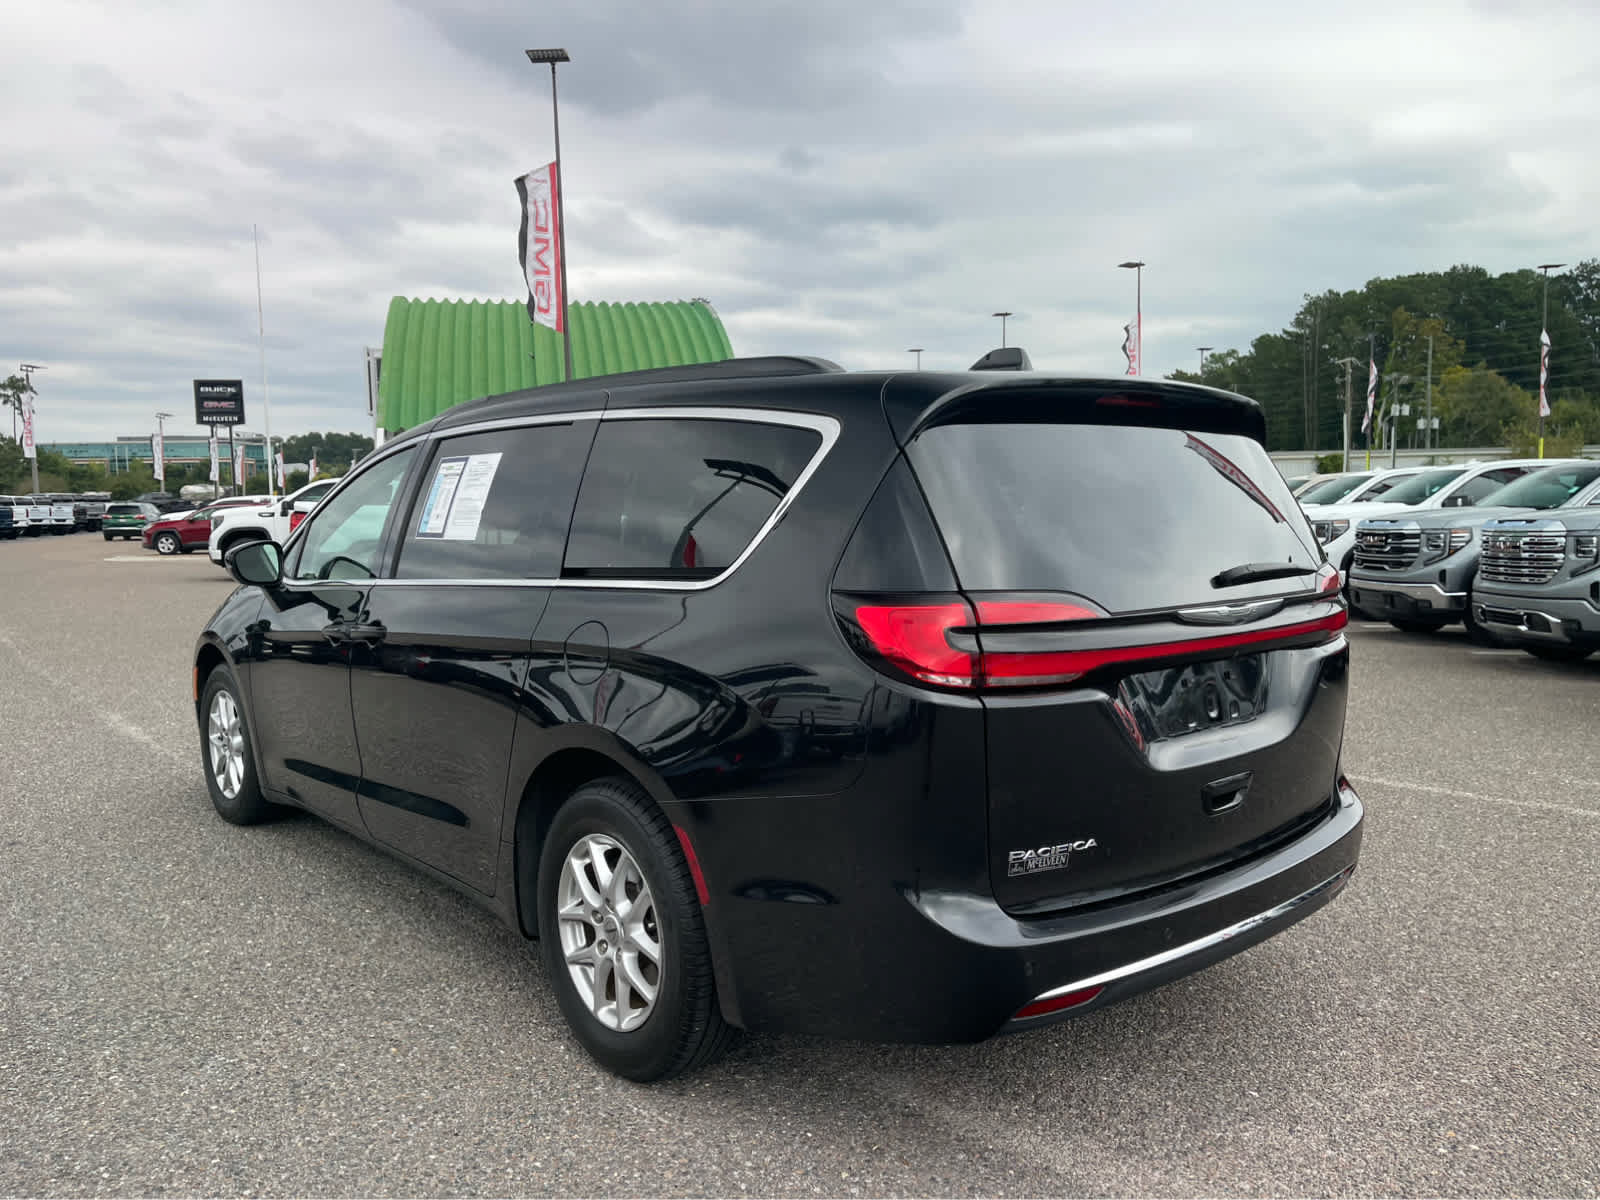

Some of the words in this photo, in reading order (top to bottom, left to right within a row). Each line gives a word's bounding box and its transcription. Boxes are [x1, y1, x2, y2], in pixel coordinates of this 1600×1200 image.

[533, 199, 551, 314] GMC
[203, 401, 236, 409] GMC
[1008, 838, 1098, 861] PACIFICA
